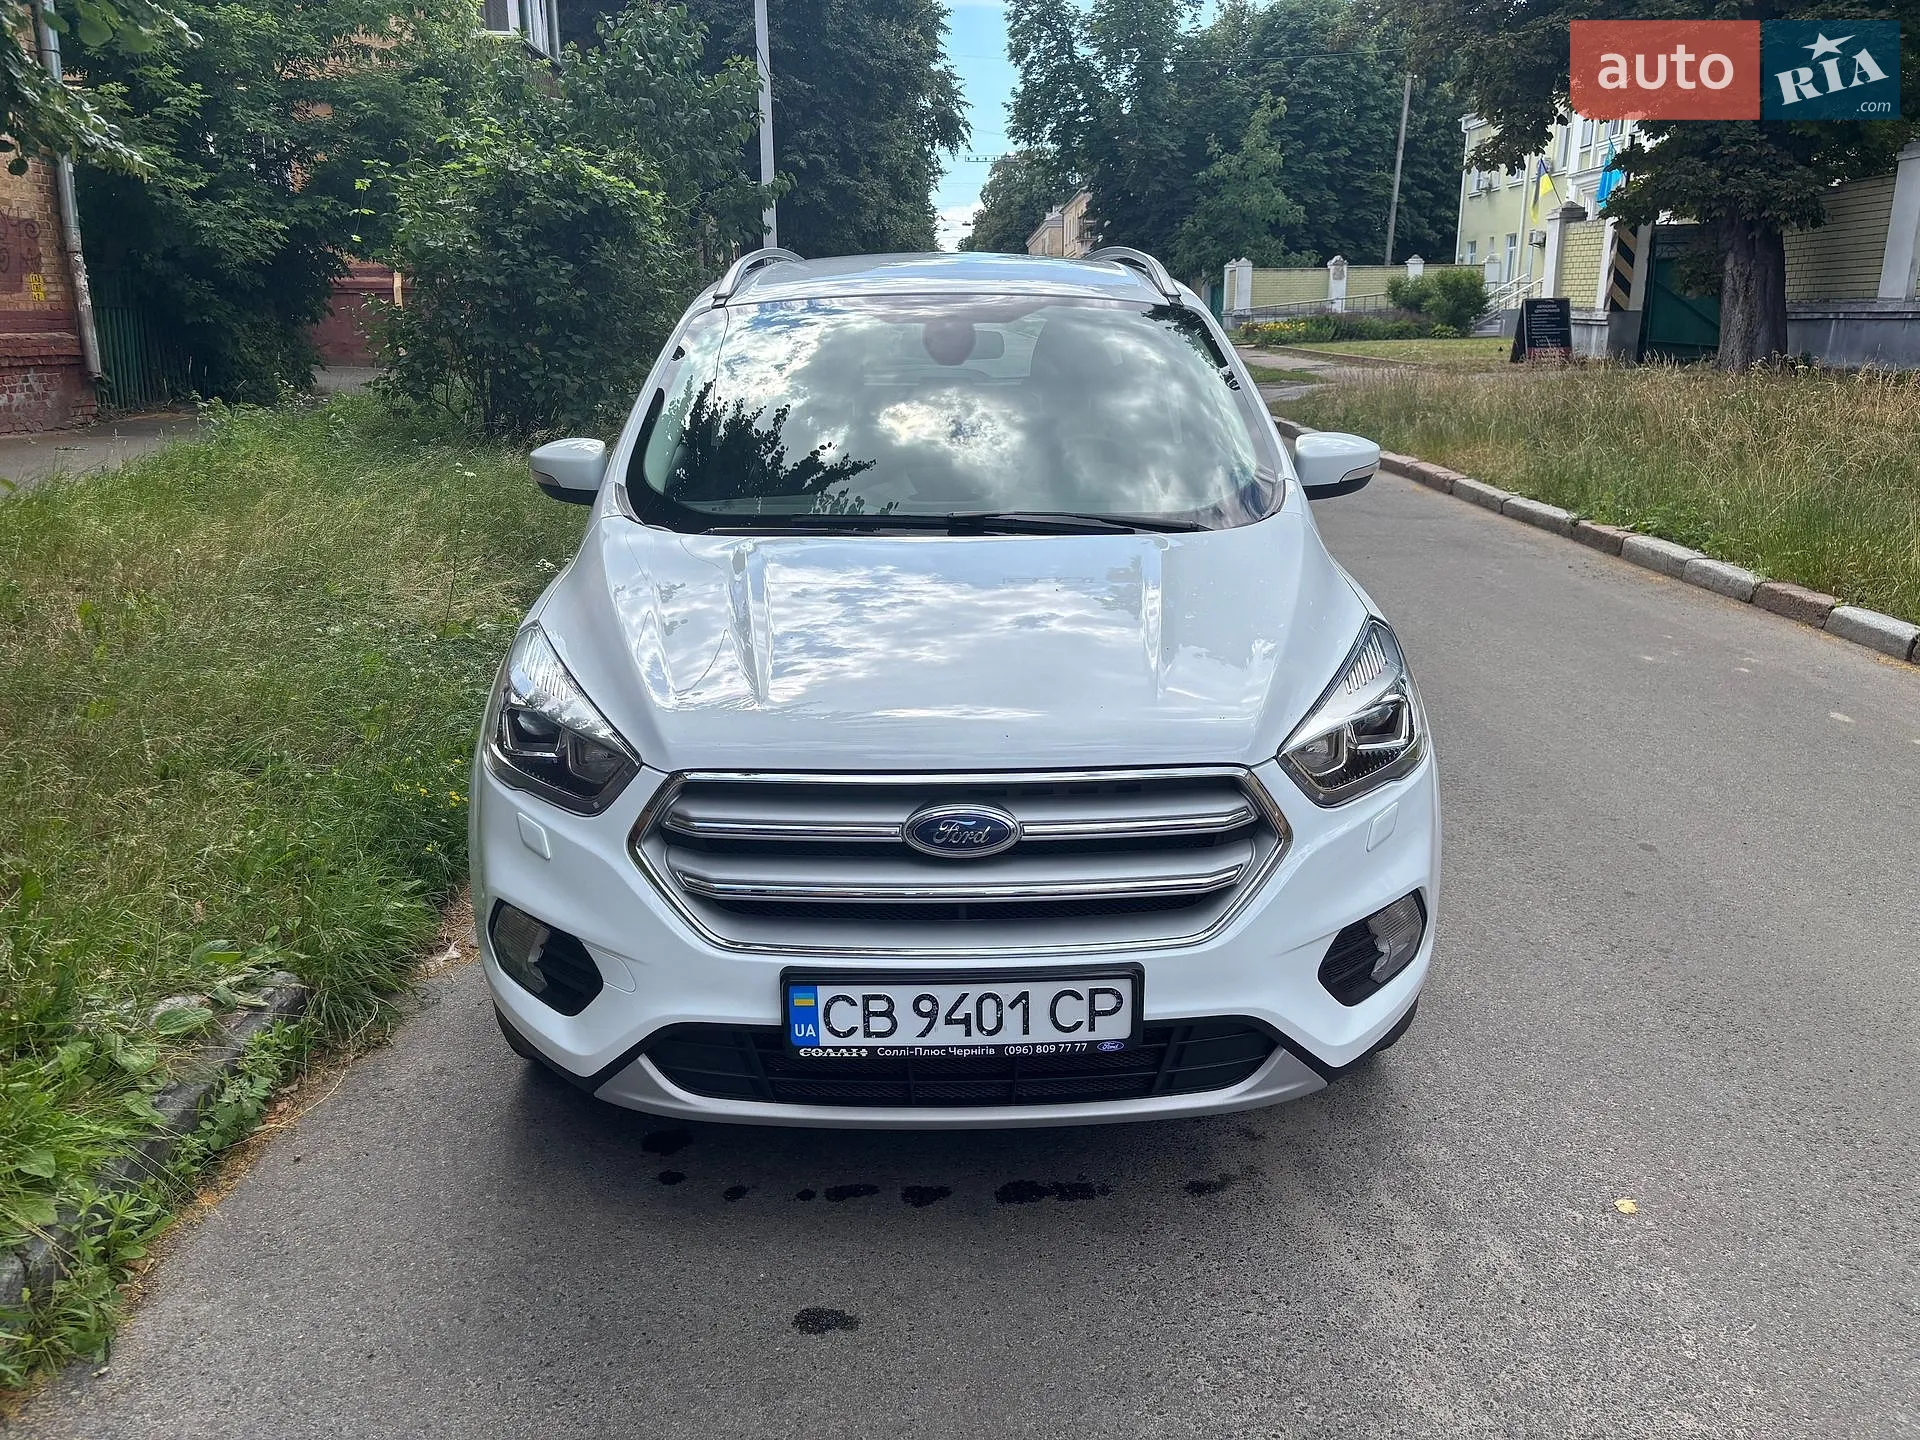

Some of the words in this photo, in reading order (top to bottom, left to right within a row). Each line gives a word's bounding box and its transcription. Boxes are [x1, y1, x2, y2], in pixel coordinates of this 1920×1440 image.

[932, 819, 991, 844] Ford
[823, 994, 898, 1038] CB
[912, 990, 1029, 1037] 9401
[1050, 987, 1123, 1033] CP
[794, 1023, 816, 1037] UA
[876, 1047, 946, 1057] Соллі-Плюс
[948, 1046, 995, 1058] Чернігів
[1004, 1044, 1033, 1056] (096)
[1035, 1044, 1056, 1054] 809
[1058, 1043, 1071, 1053] 77
[1074, 1042, 1088, 1052] 77
